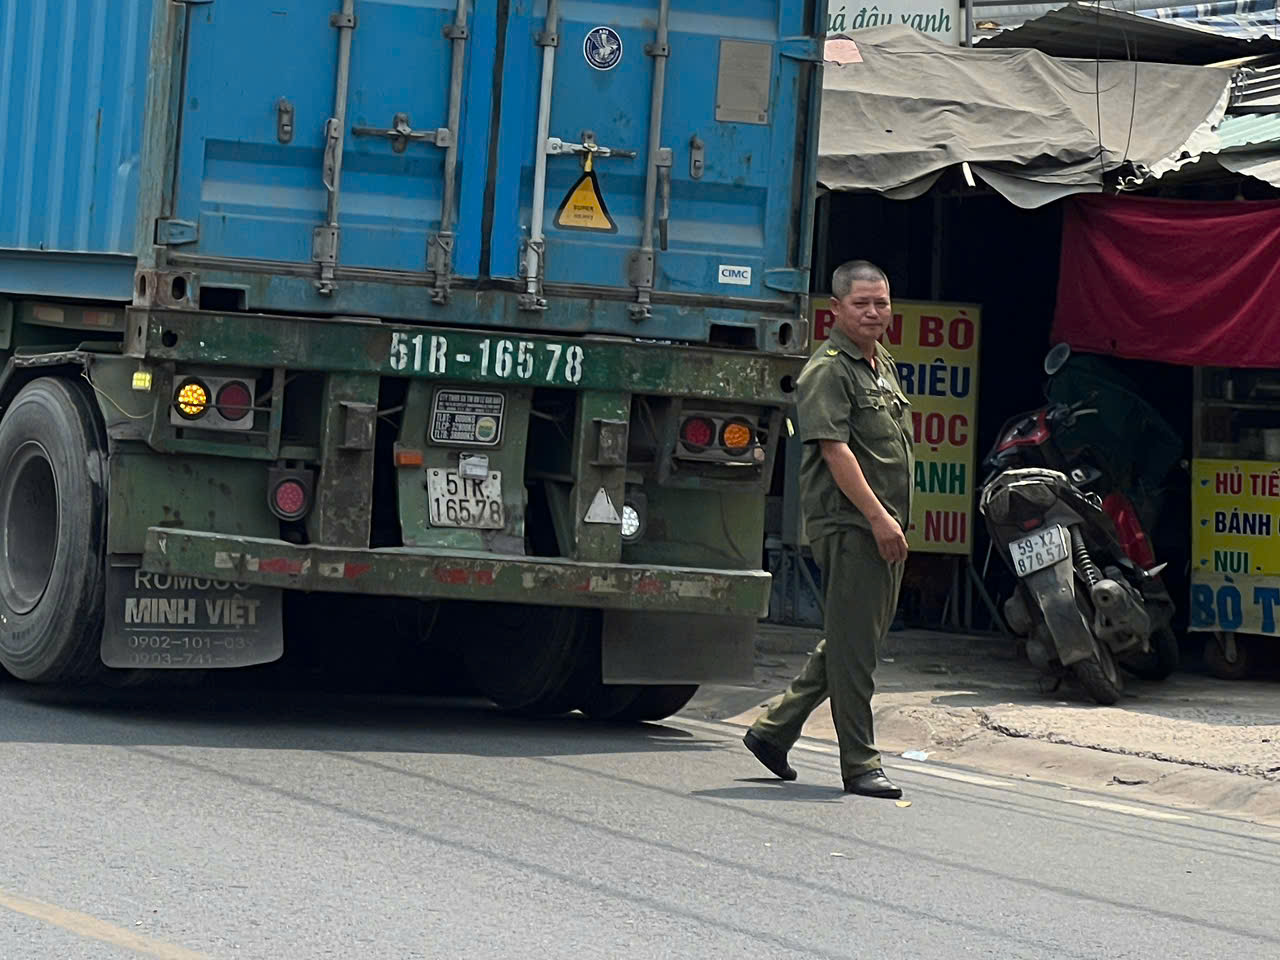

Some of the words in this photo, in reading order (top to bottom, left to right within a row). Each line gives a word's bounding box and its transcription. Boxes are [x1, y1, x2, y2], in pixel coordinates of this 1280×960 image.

[721, 268, 748, 280] CIMC
[814, 309, 904, 346] BN
[919, 310, 975, 350] BÒ
[900, 357, 970, 398] RIÊU
[446, 472, 484, 498] 51R
[1216, 465, 1242, 495] HỦ
[925, 510, 966, 544] NUI
[1214, 507, 1271, 536] BÁNH
[1018, 531, 1056, 556] 59-X2
[1214, 550, 1249, 574] NUI
[125, 598, 196, 625] MINH
[206, 593, 261, 629] VIỆT
[1191, 575, 1243, 631] BÒ
